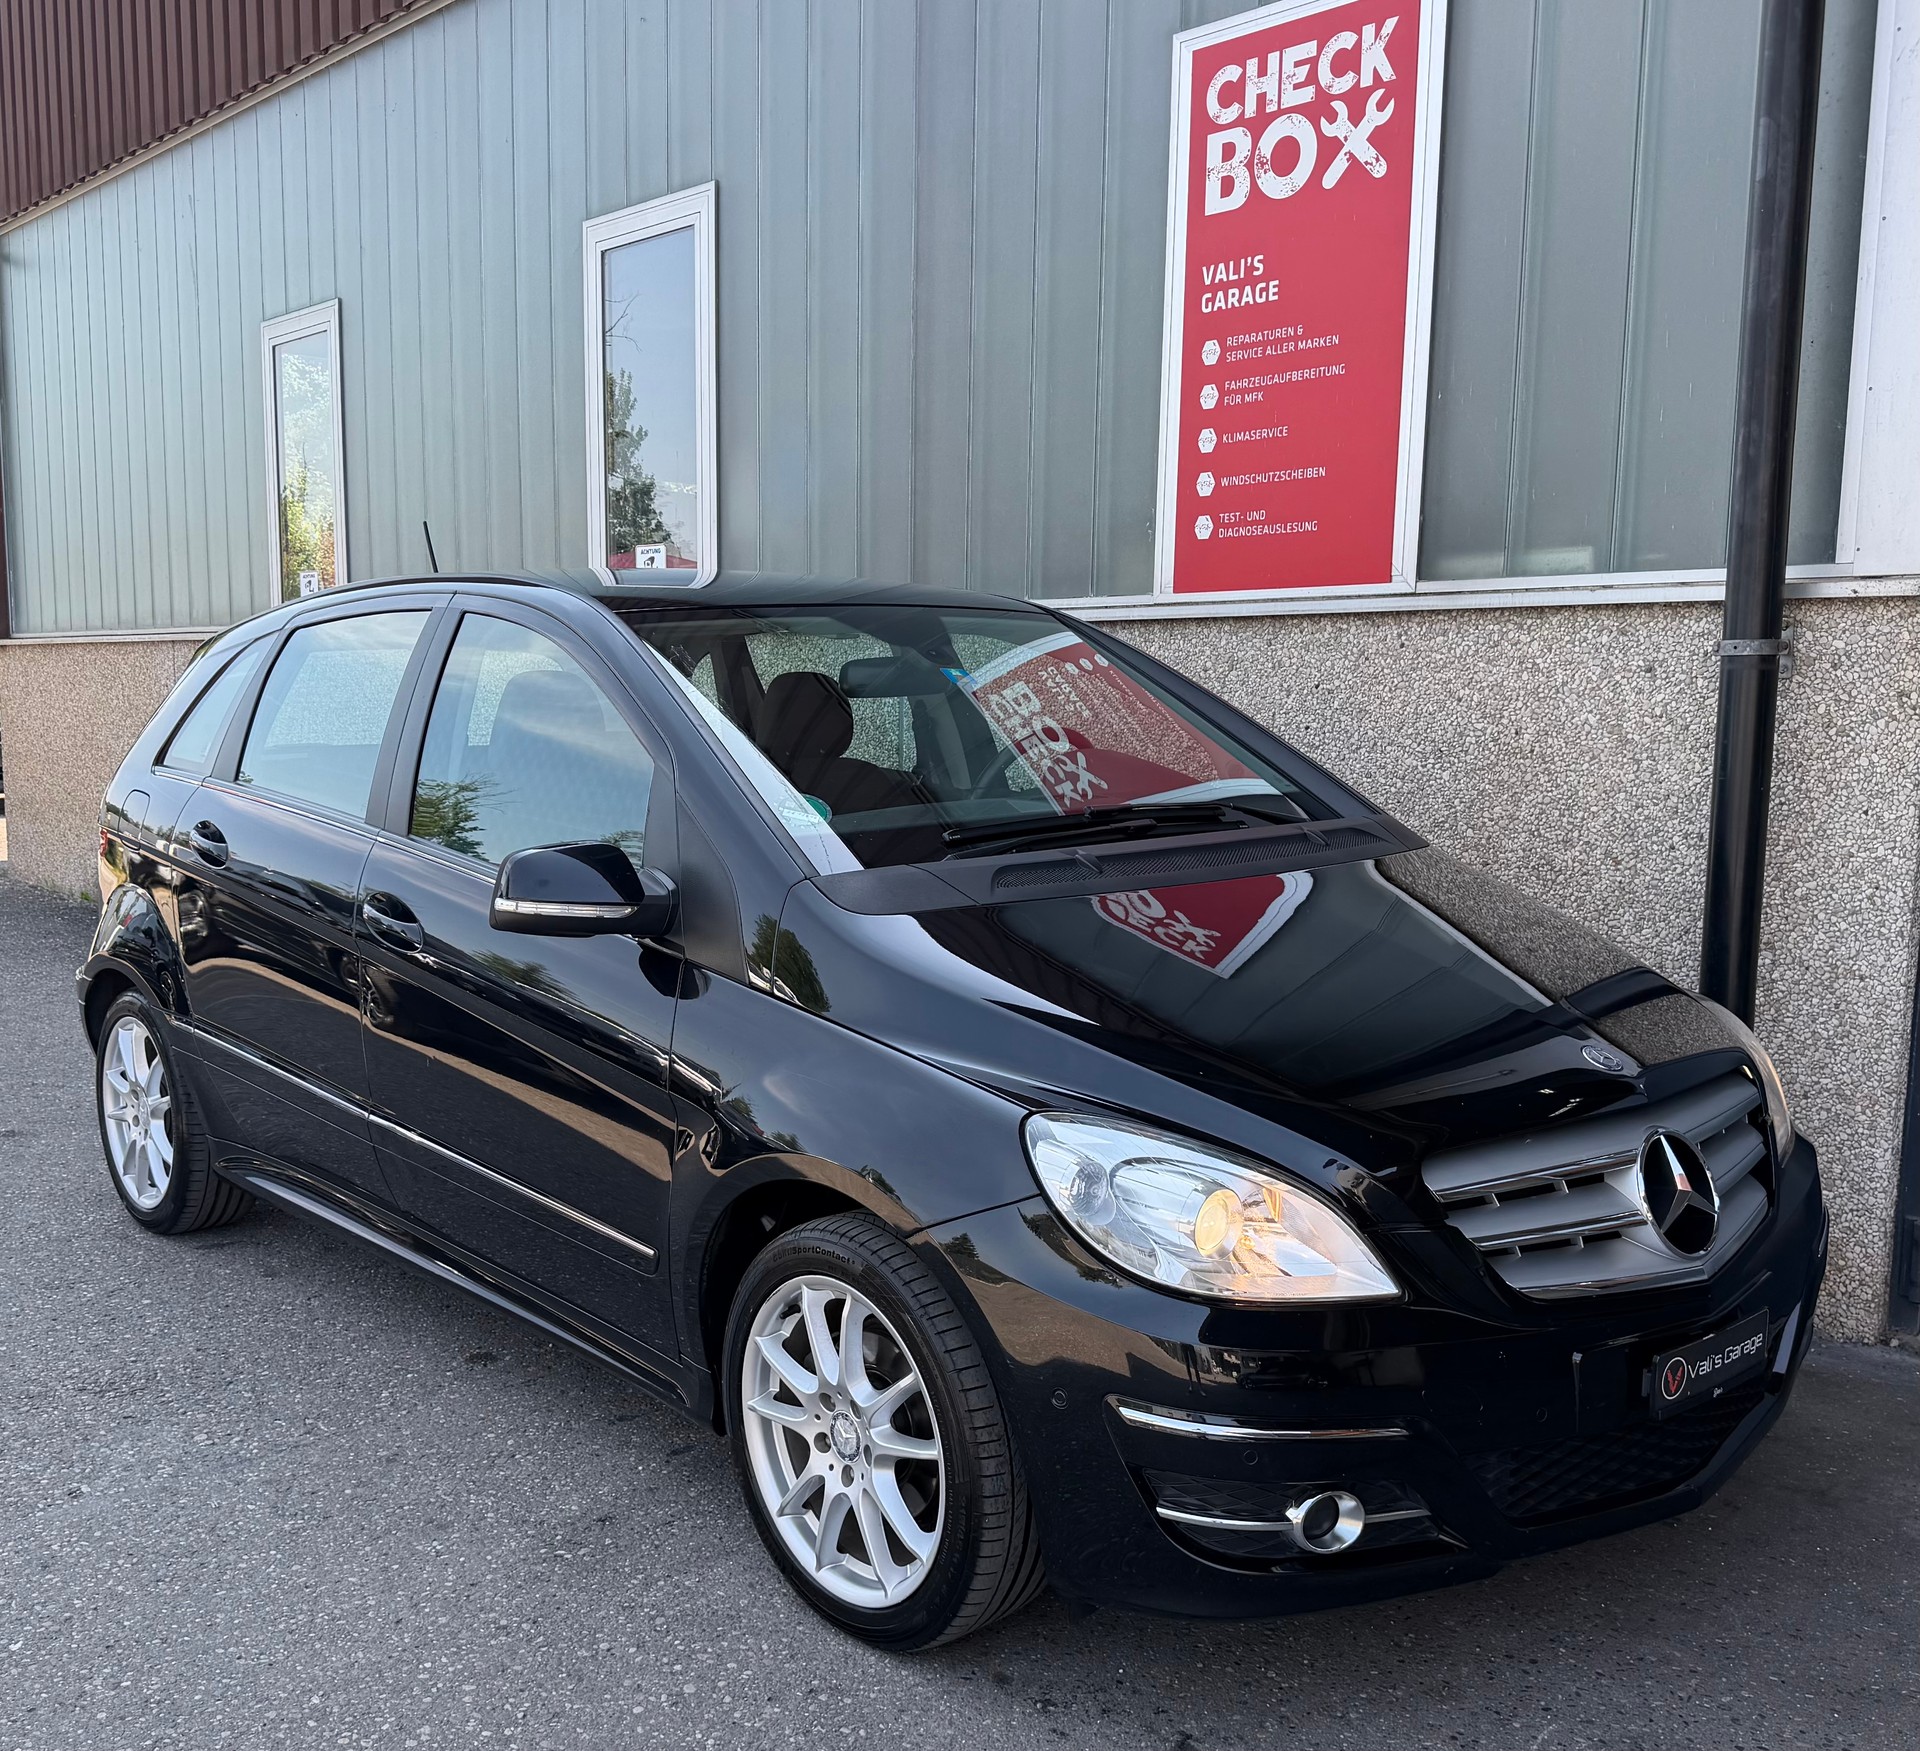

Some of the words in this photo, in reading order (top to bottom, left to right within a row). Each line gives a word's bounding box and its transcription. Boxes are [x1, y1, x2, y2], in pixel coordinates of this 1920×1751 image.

[1206, 16, 1400, 125] CHECK
[1204, 89, 1395, 216] BOX
[1202, 255, 1264, 286] VALI'S
[1201, 280, 1280, 314] GARAGE
[1225, 346, 1263, 363] SERVICE
[1265, 341, 1295, 357] ALLER
[1298, 334, 1340, 351] MARKEN
[1226, 326, 1294, 347] REPARATUREN
[1297, 324, 1304, 336] &
[1224, 363, 1346, 391] FAHRZEUGAUFBEREITUNG
[1224, 393, 1242, 406] FÜR
[1244, 391, 1264, 404] MFK
[1222, 426, 1289, 444] KLIMASERVICE
[1220, 466, 1326, 487] WINDSCHUTZSCHEIBEN
[1218, 520, 1318, 538] DIAGNOSEAUSLESUNG
[1219, 511, 1244, 524] TEST-
[1246, 510, 1266, 521] UND
[1688, 1353, 1722, 1379] Vali's
[1724, 1333, 1763, 1364] Garage
